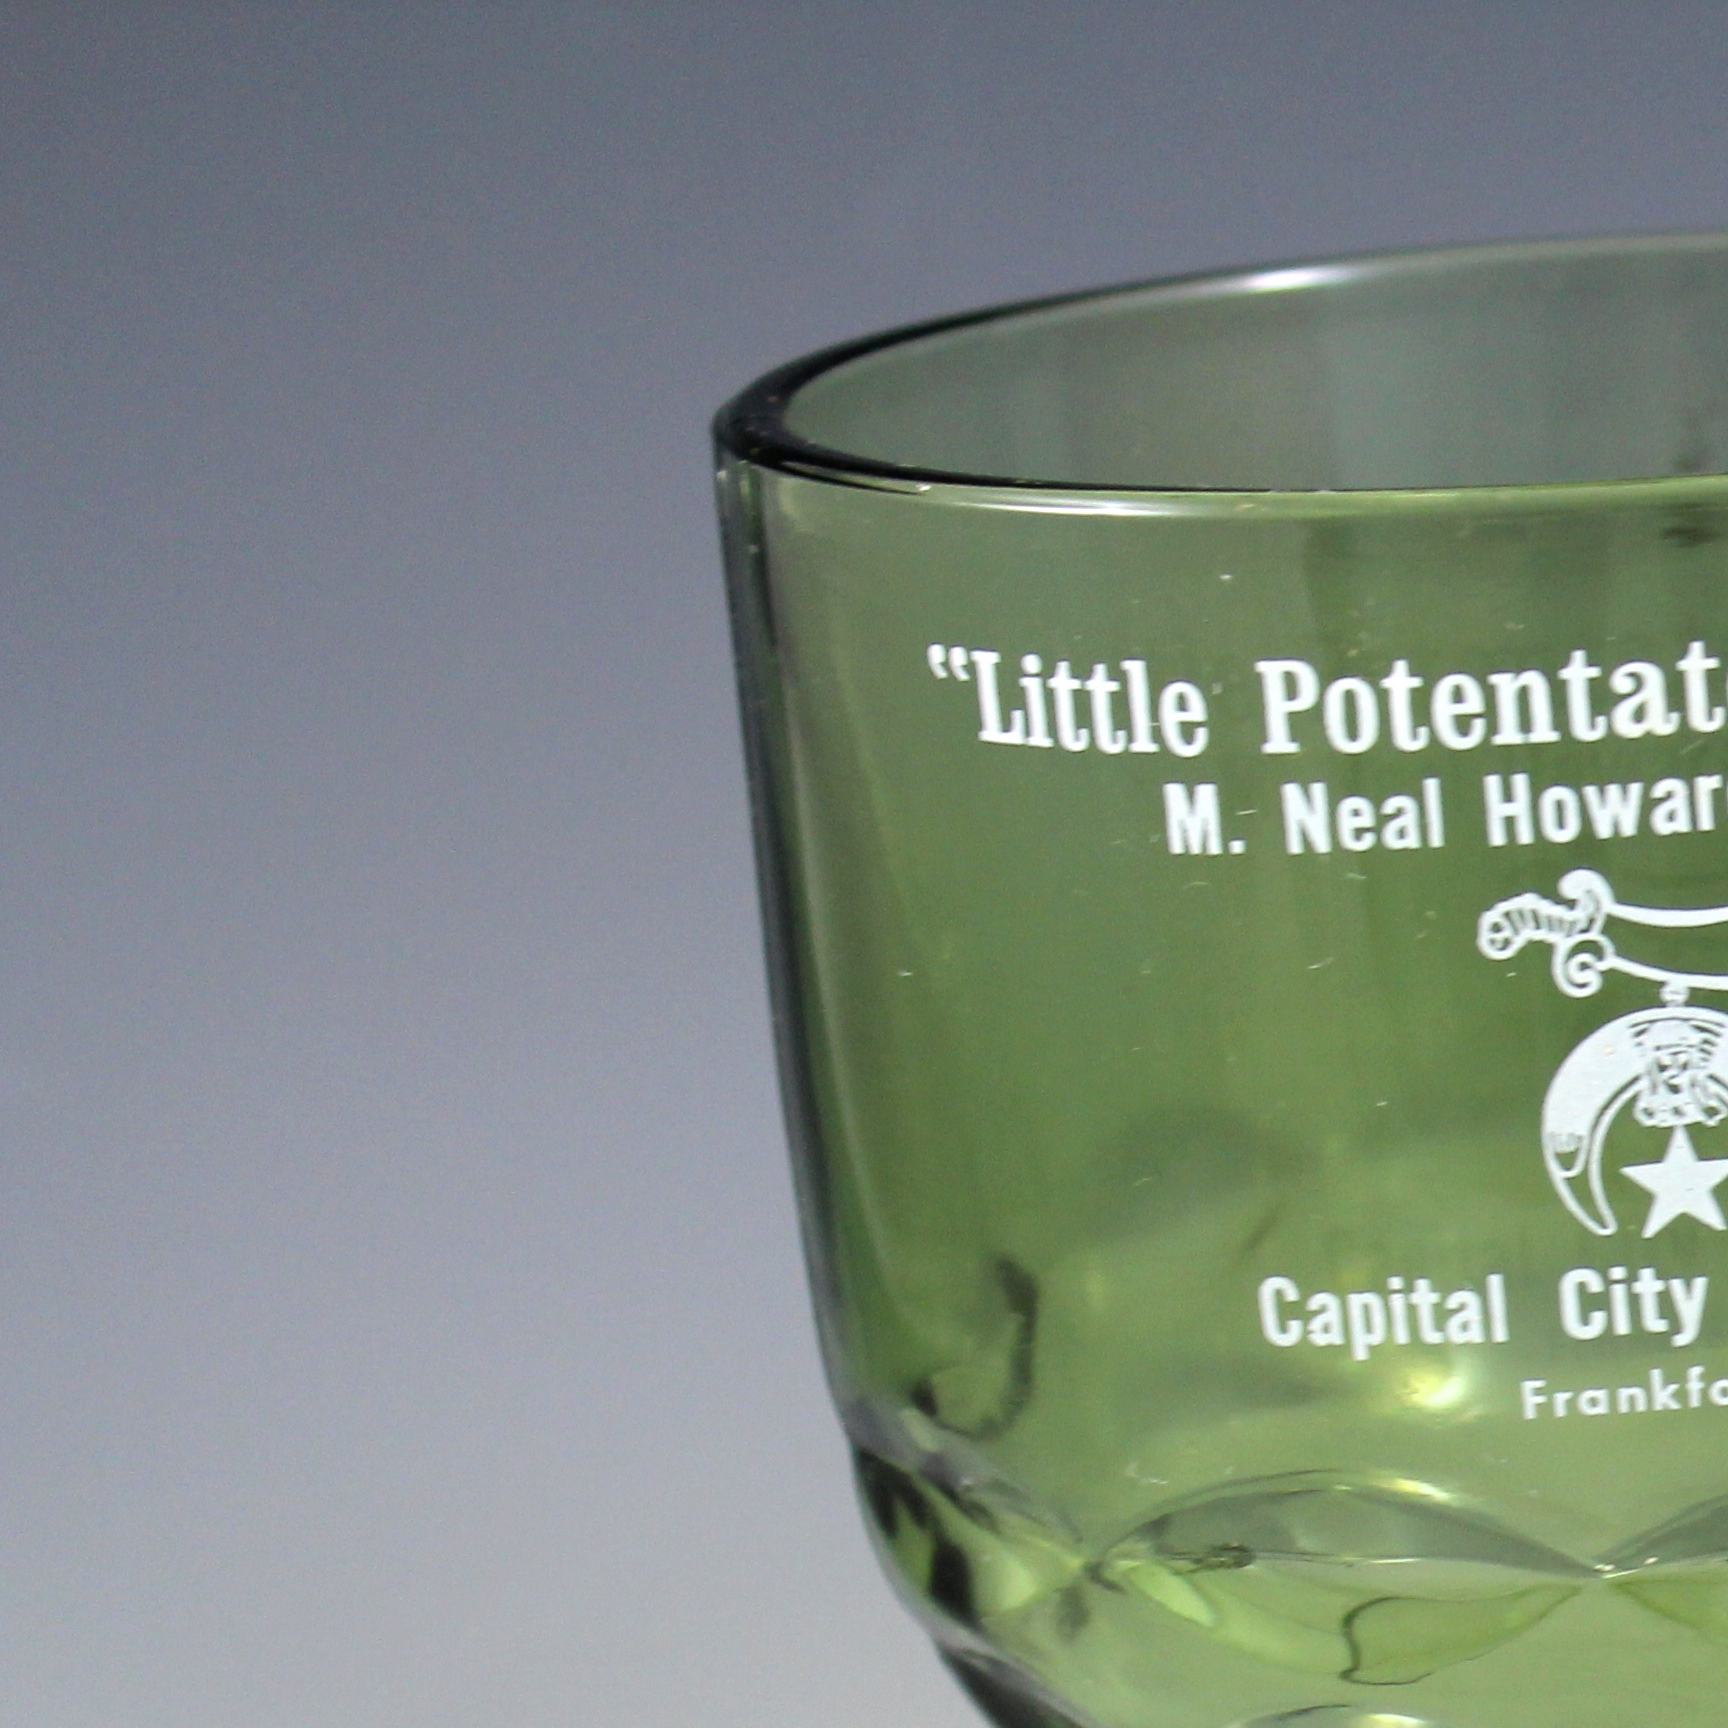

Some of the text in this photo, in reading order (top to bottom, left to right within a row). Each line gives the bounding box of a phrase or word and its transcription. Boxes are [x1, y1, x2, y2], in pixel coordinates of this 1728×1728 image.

[1163, 782, 1246, 855] M.
[1280, 778, 1443, 854] Neal
[1257, 1273, 1510, 1362] Capital
[1558, 1266, 1709, 1348] City
